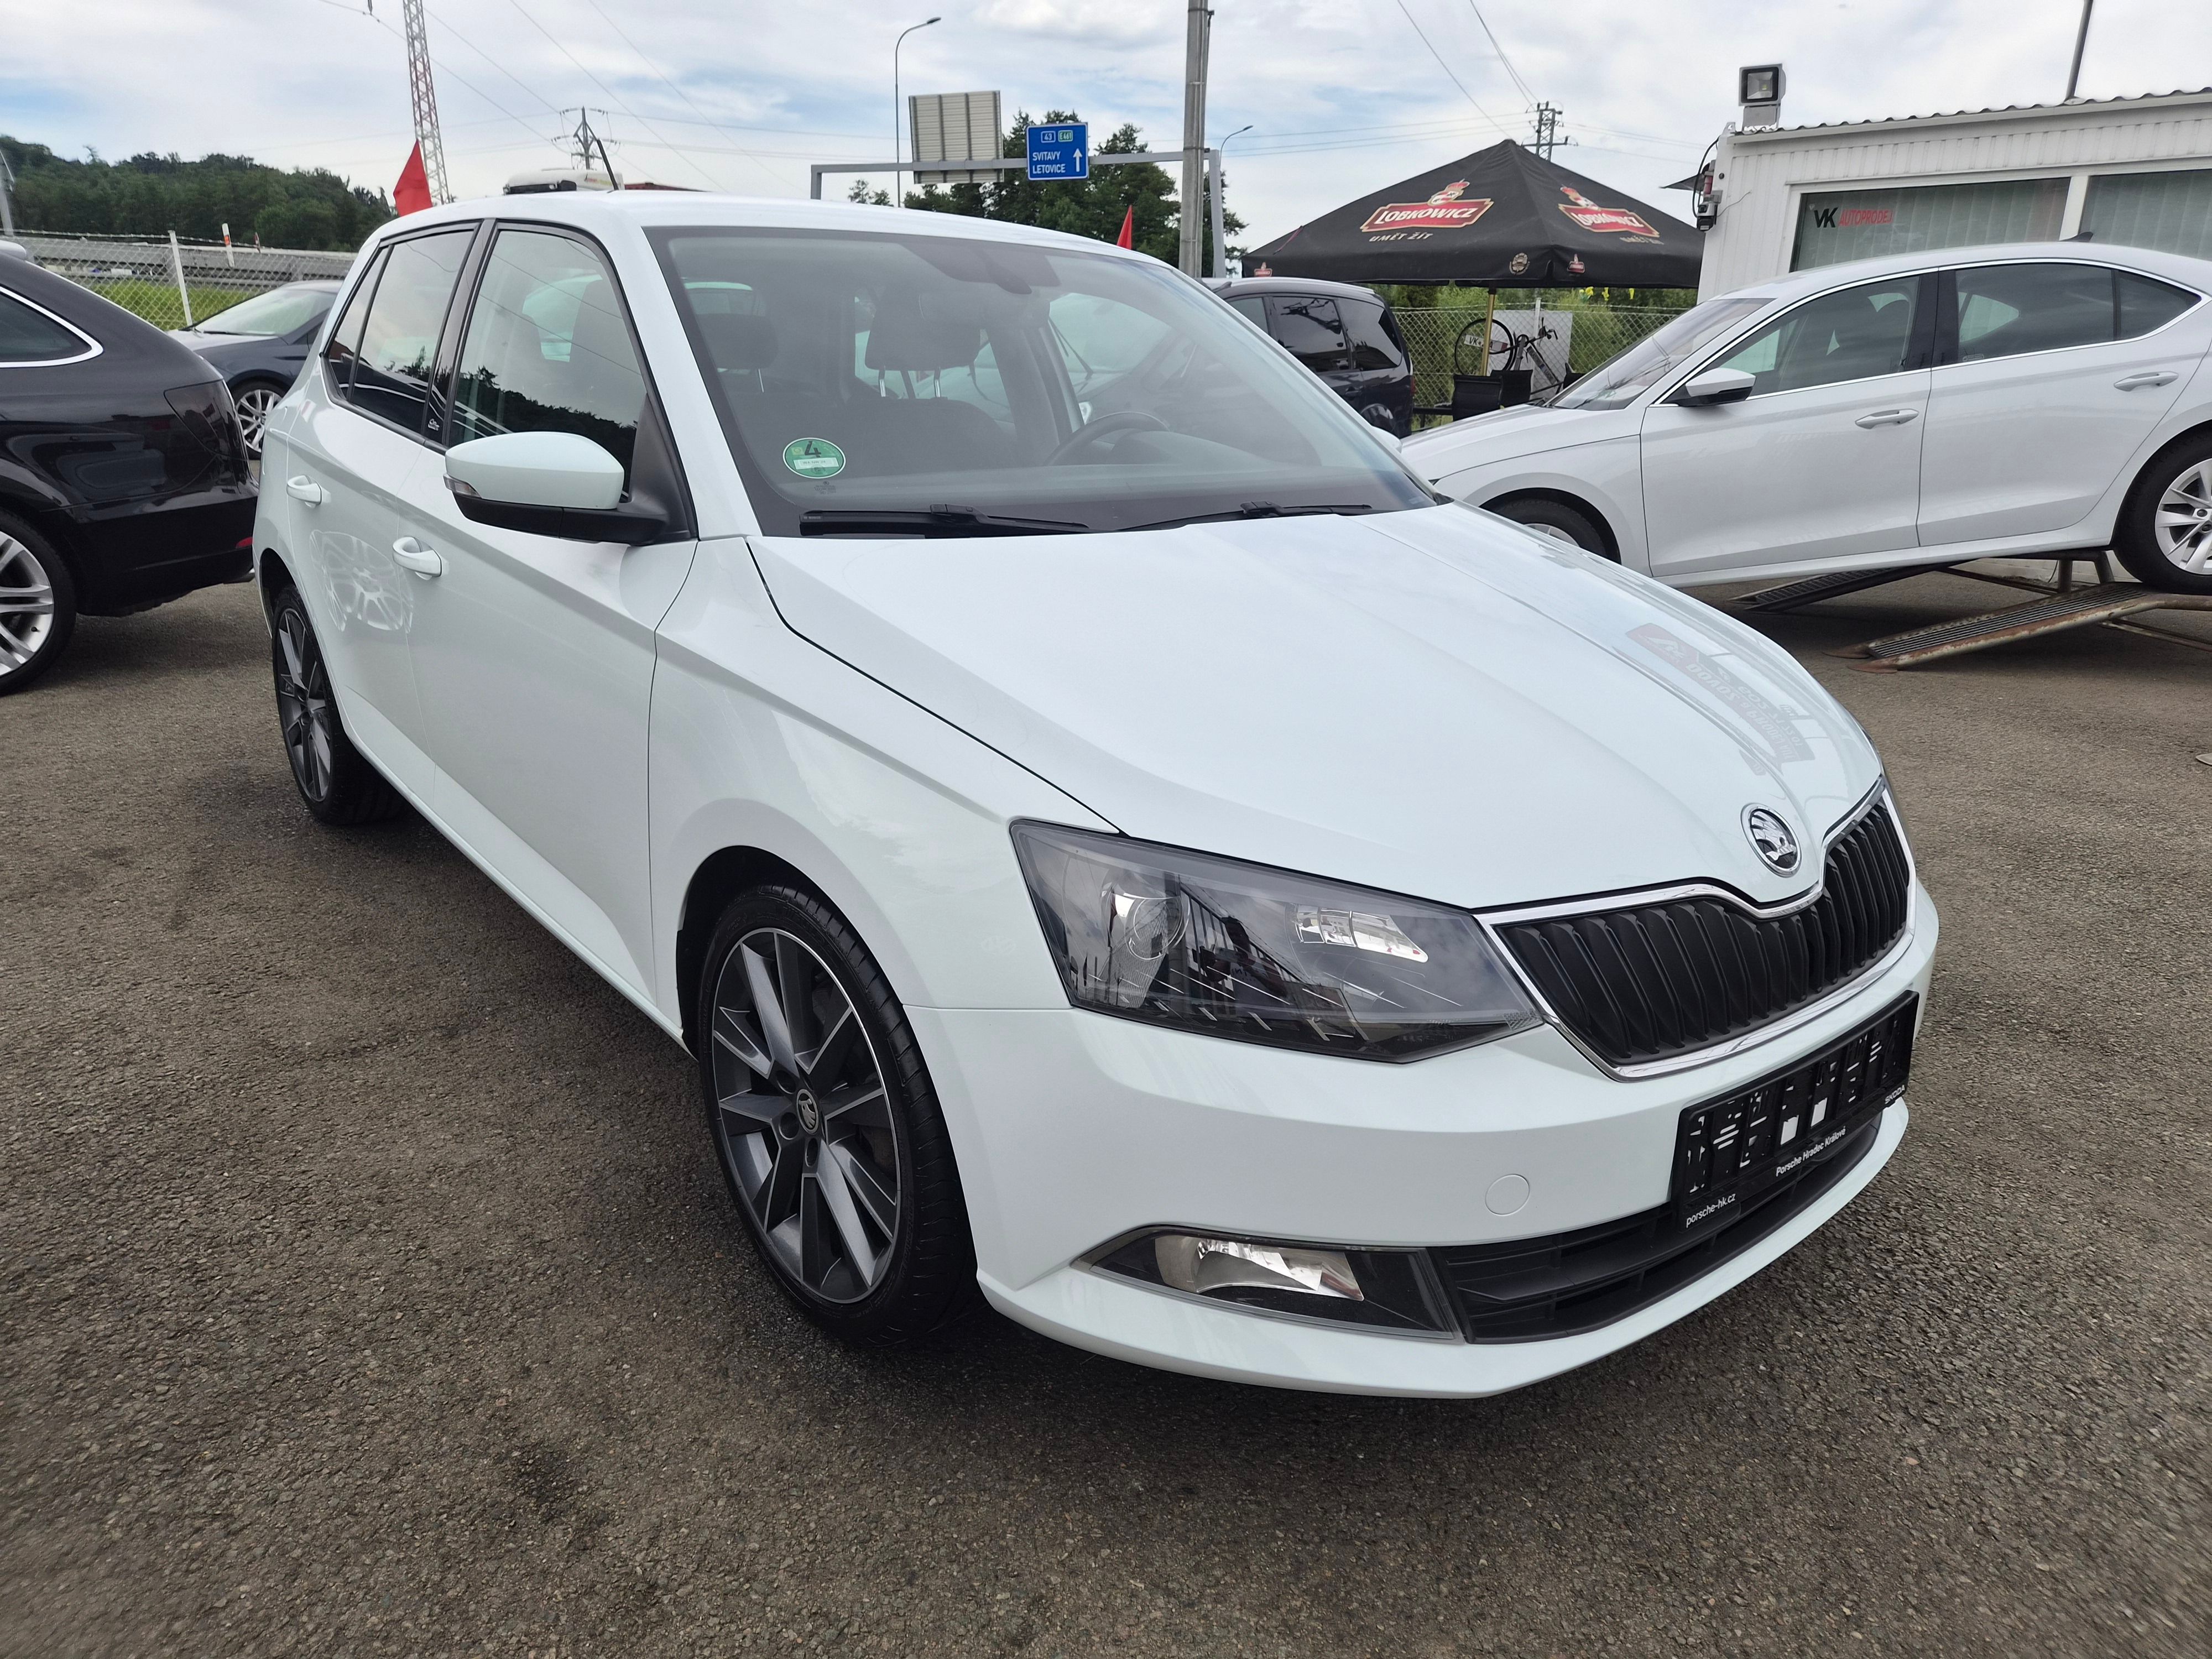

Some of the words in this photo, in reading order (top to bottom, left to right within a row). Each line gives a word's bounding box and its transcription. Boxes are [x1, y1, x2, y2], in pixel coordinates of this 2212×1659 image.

[1032, 151, 1061, 161] SVITAVY
[1032, 164, 1066, 174] LETOVICE
[1374, 208, 1478, 225] LOBKOWICZ
[1814, 207, 1838, 228] VK
[1839, 210, 1893, 226] AUTOPRODEJ
[1369, 232, 1408, 242] UMĚT
[804, 441, 822, 458] 4
[1776, 1157, 1802, 1177] Porsche
[1803, 1142, 1824, 1161] Hradec
[1825, 1125, 1846, 1147] Králové
[1686, 1193, 1736, 1229] porsche-hk.cz
